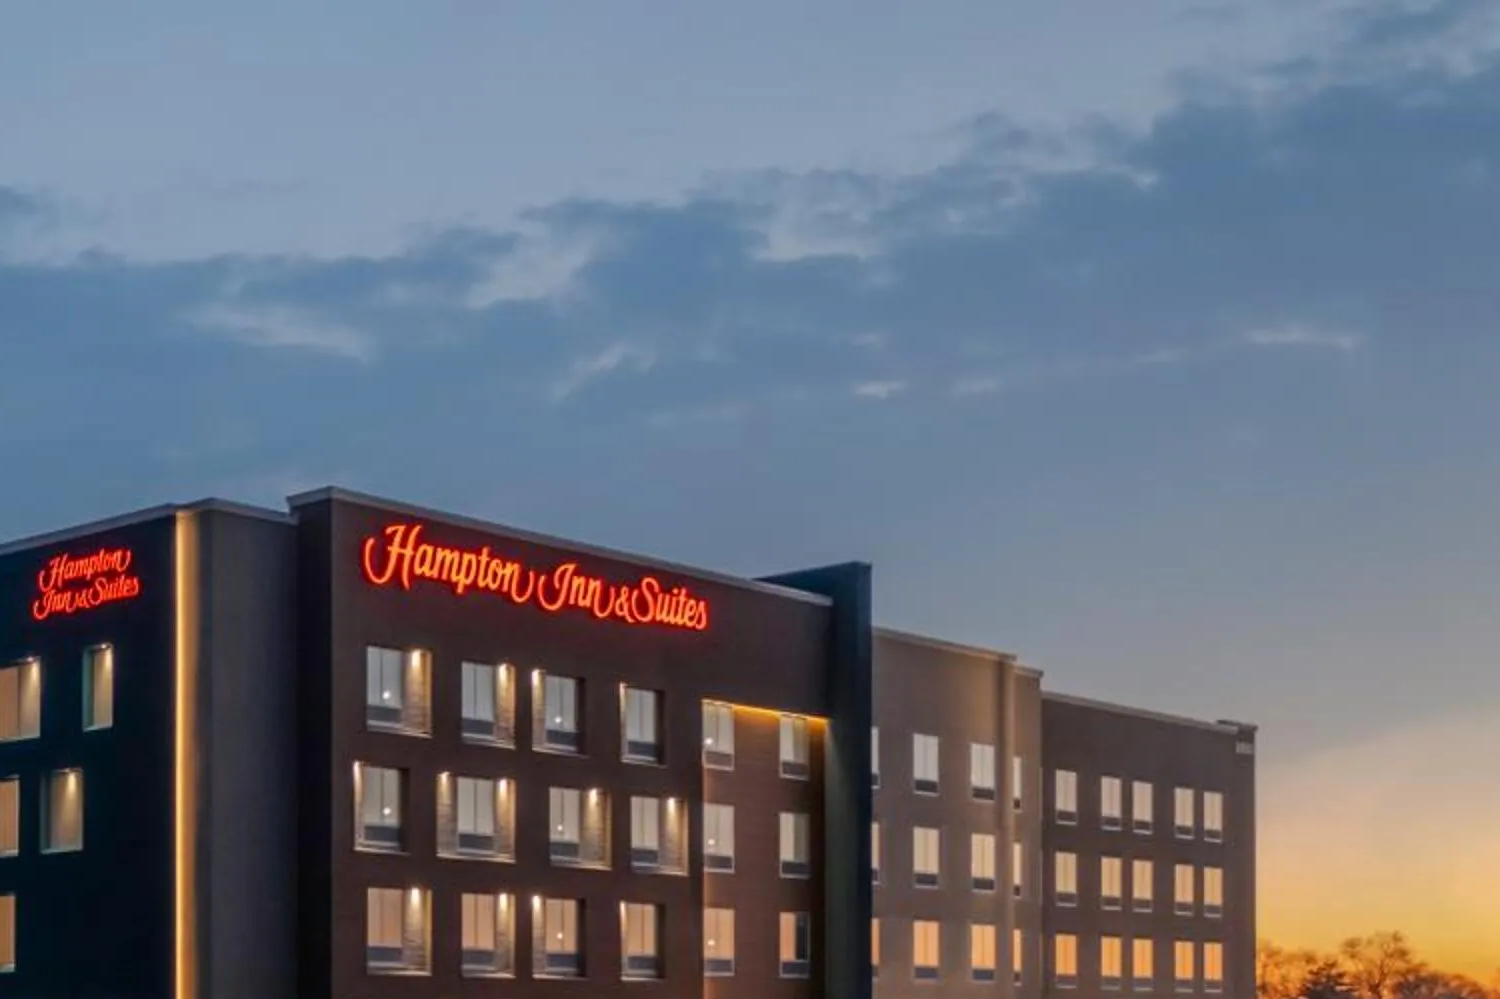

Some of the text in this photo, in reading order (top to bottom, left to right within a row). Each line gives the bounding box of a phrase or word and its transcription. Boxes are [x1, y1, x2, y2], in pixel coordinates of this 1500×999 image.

[39, 548, 131, 592] Hampton
[365, 523, 707, 631] Hampton Inn & Suites
[33, 589, 77, 619] Inn
[88, 574, 139, 605] Suites
